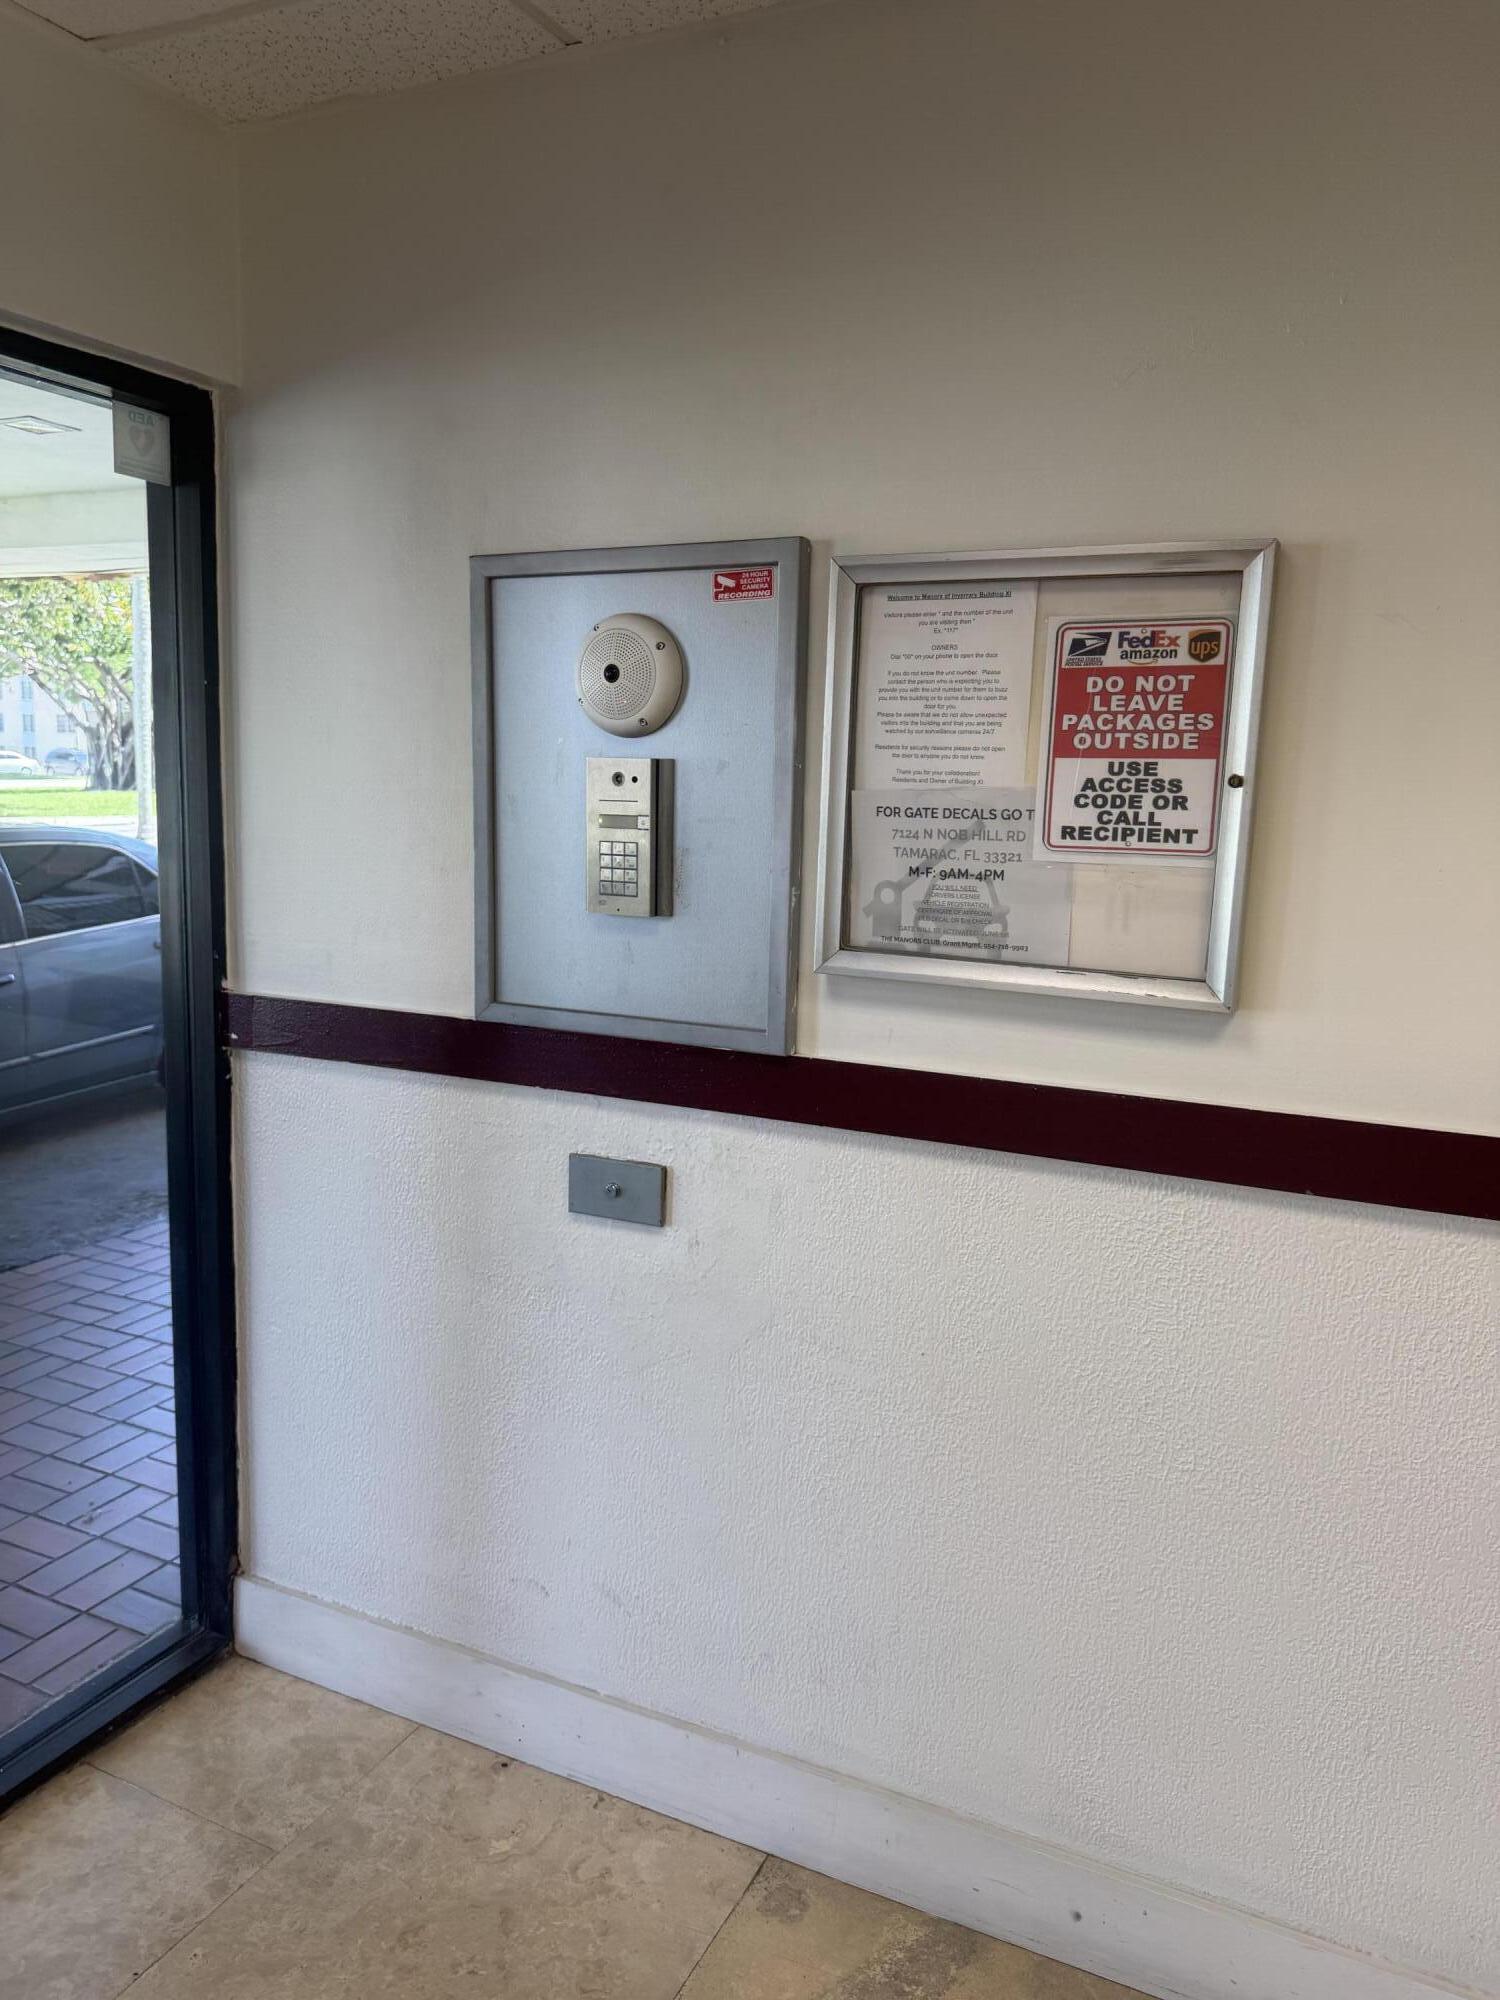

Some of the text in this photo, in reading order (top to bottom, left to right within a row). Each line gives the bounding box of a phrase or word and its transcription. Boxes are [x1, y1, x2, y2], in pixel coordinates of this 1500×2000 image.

[718, 590, 770, 599] RECORDING
[1118, 630, 1180, 648] FedEx
[1120, 648, 1178, 660] amazon
[1191, 640, 1218, 659] ups
[1086, 674, 1195, 692] DO NOT
[1093, 694, 1184, 712] LEAVE
[1062, 713, 1214, 730] PACKAGES
[1072, 732, 1198, 750] OUTSIDE
[1108, 762, 1158, 776] USE
[1080, 778, 1182, 793] ACCESS
[1074, 794, 1188, 810] CODE OR
[876, 806, 1036, 820] FOR GATE DECALS GO T
[1096, 810, 1162, 826] CALL
[891, 828, 1026, 842] 7124 N NOB HILL RD
[1060, 826, 1198, 844] RECIPIENT
[893, 846, 1023, 864] TAMARAC, FL 33321
[908, 866, 1005, 882] M-F: 9AM-4PM
[894, 936, 922, 944] MANORS
